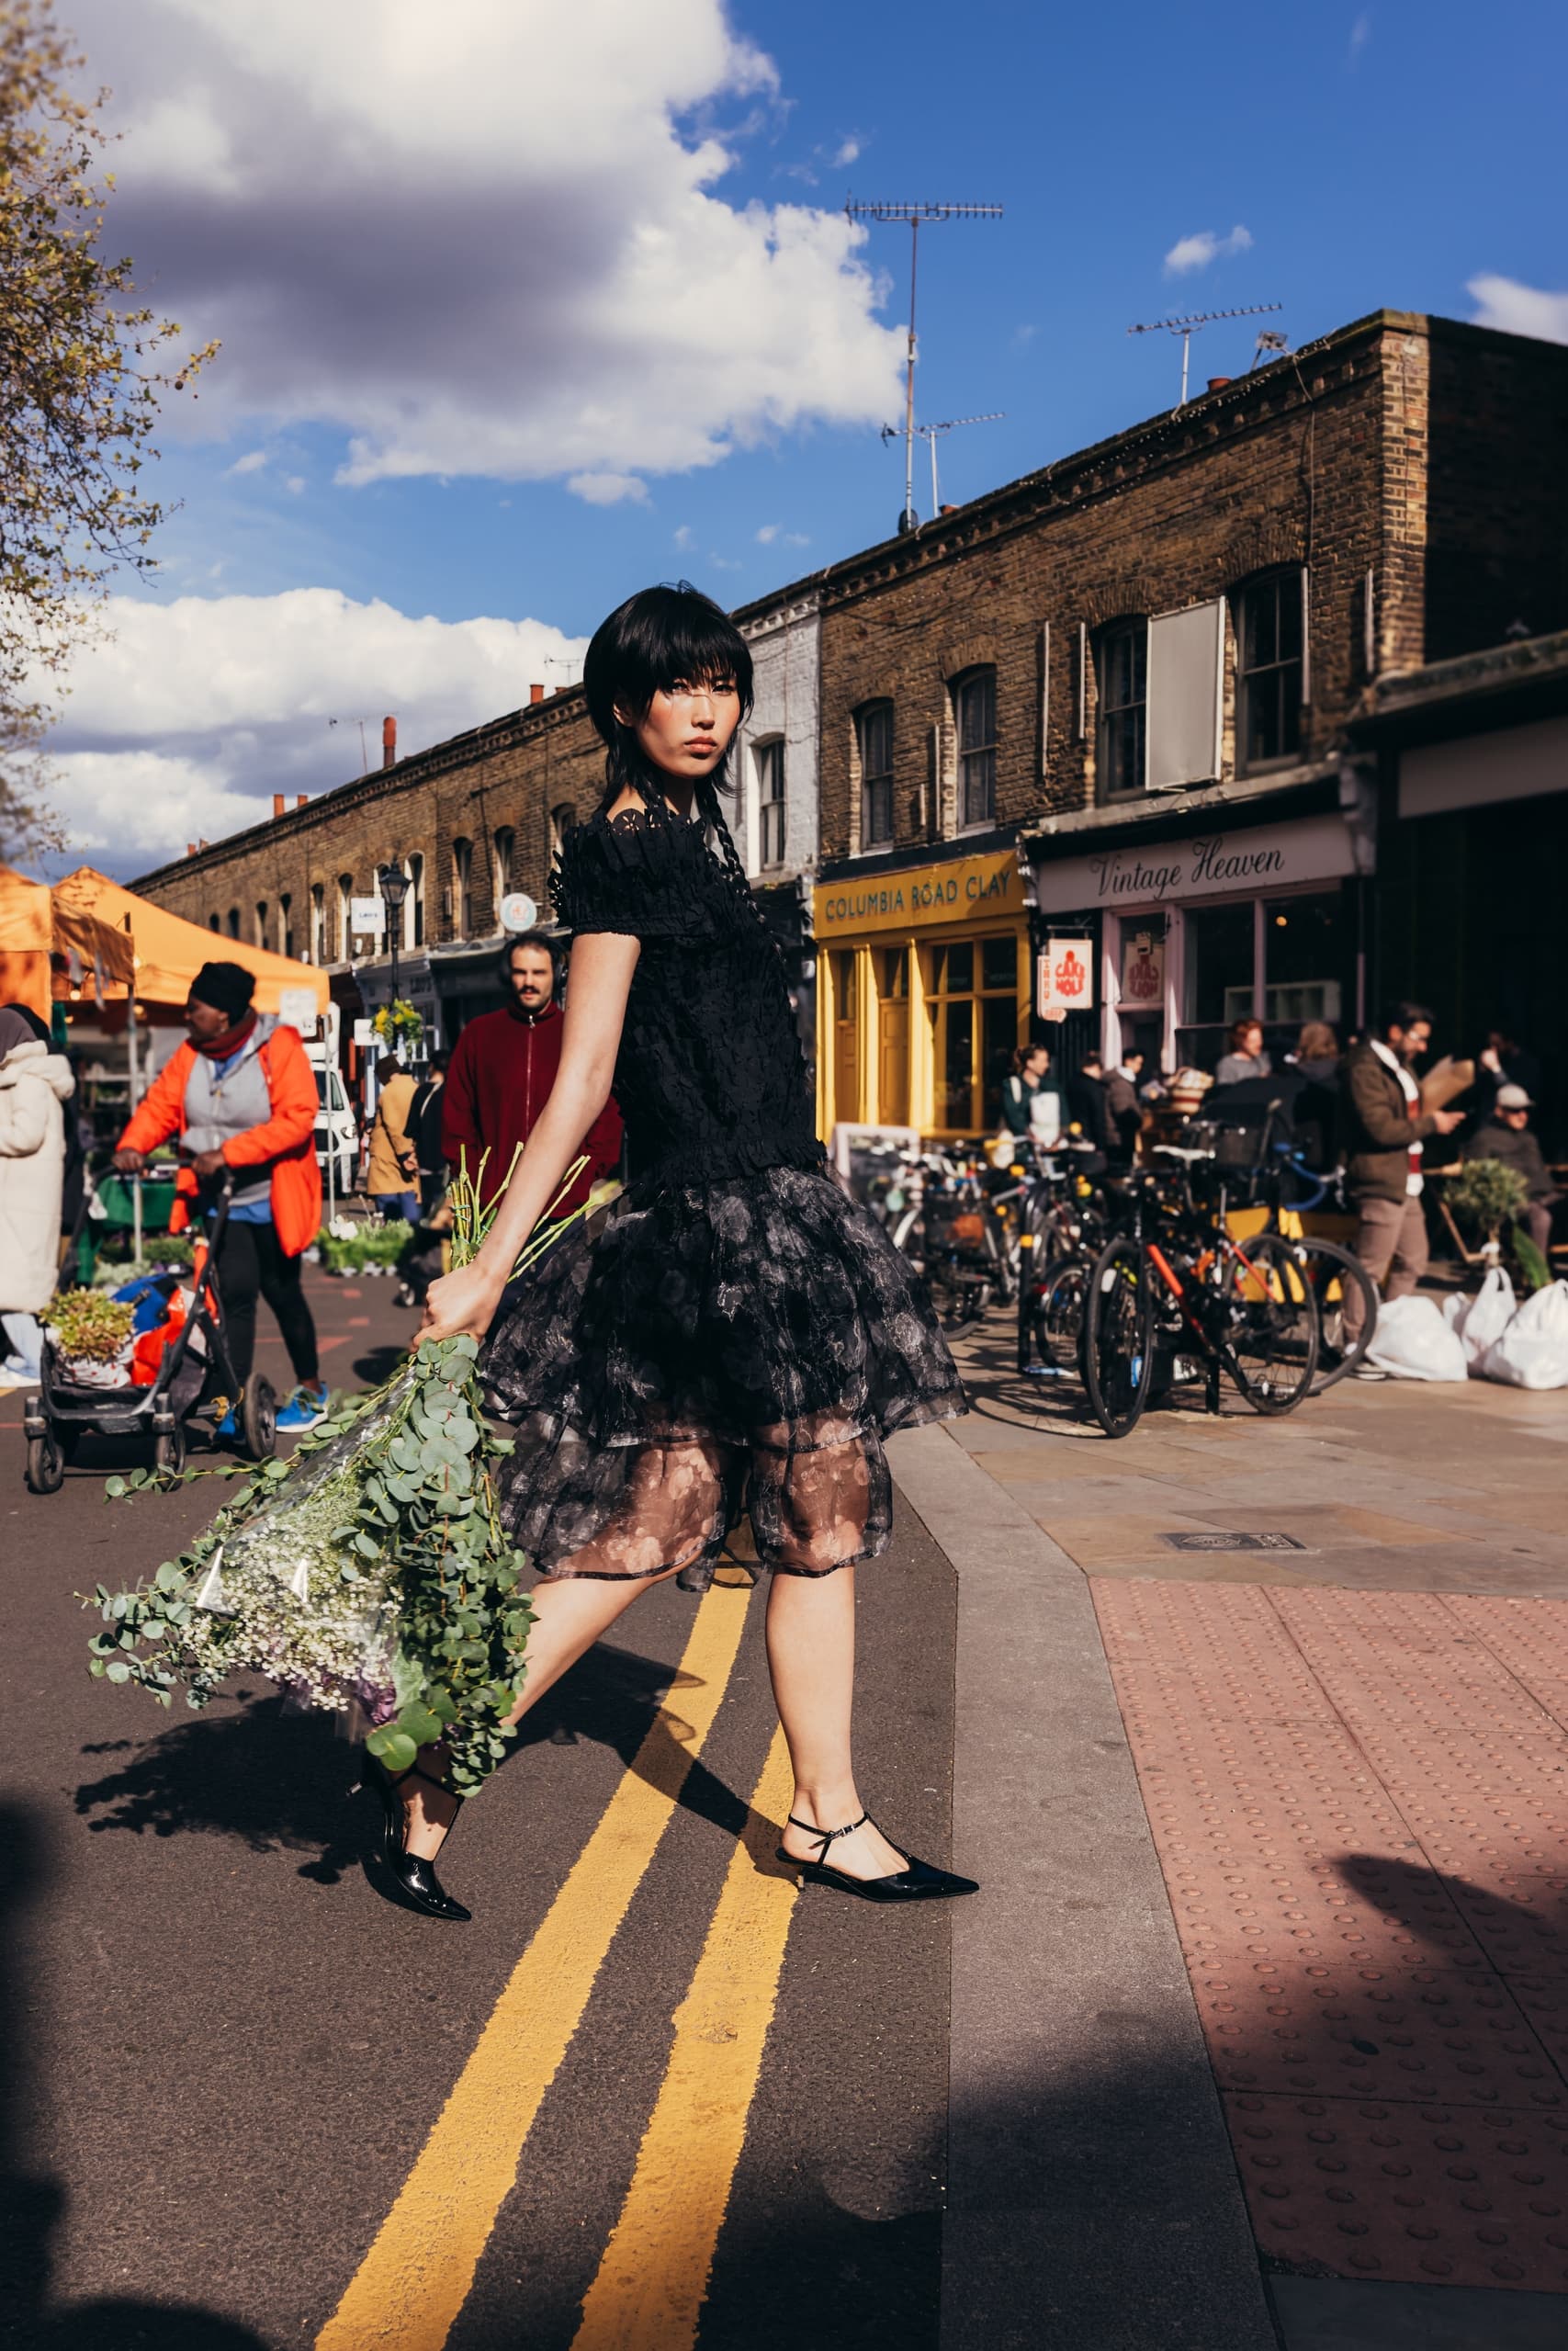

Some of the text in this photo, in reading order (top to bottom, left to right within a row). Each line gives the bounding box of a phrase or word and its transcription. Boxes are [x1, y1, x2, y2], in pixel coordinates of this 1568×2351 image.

[826, 873, 1010, 920] COLUMBIA ROAD CLAY
[1089, 837, 1284, 901] Vintage Heaven
